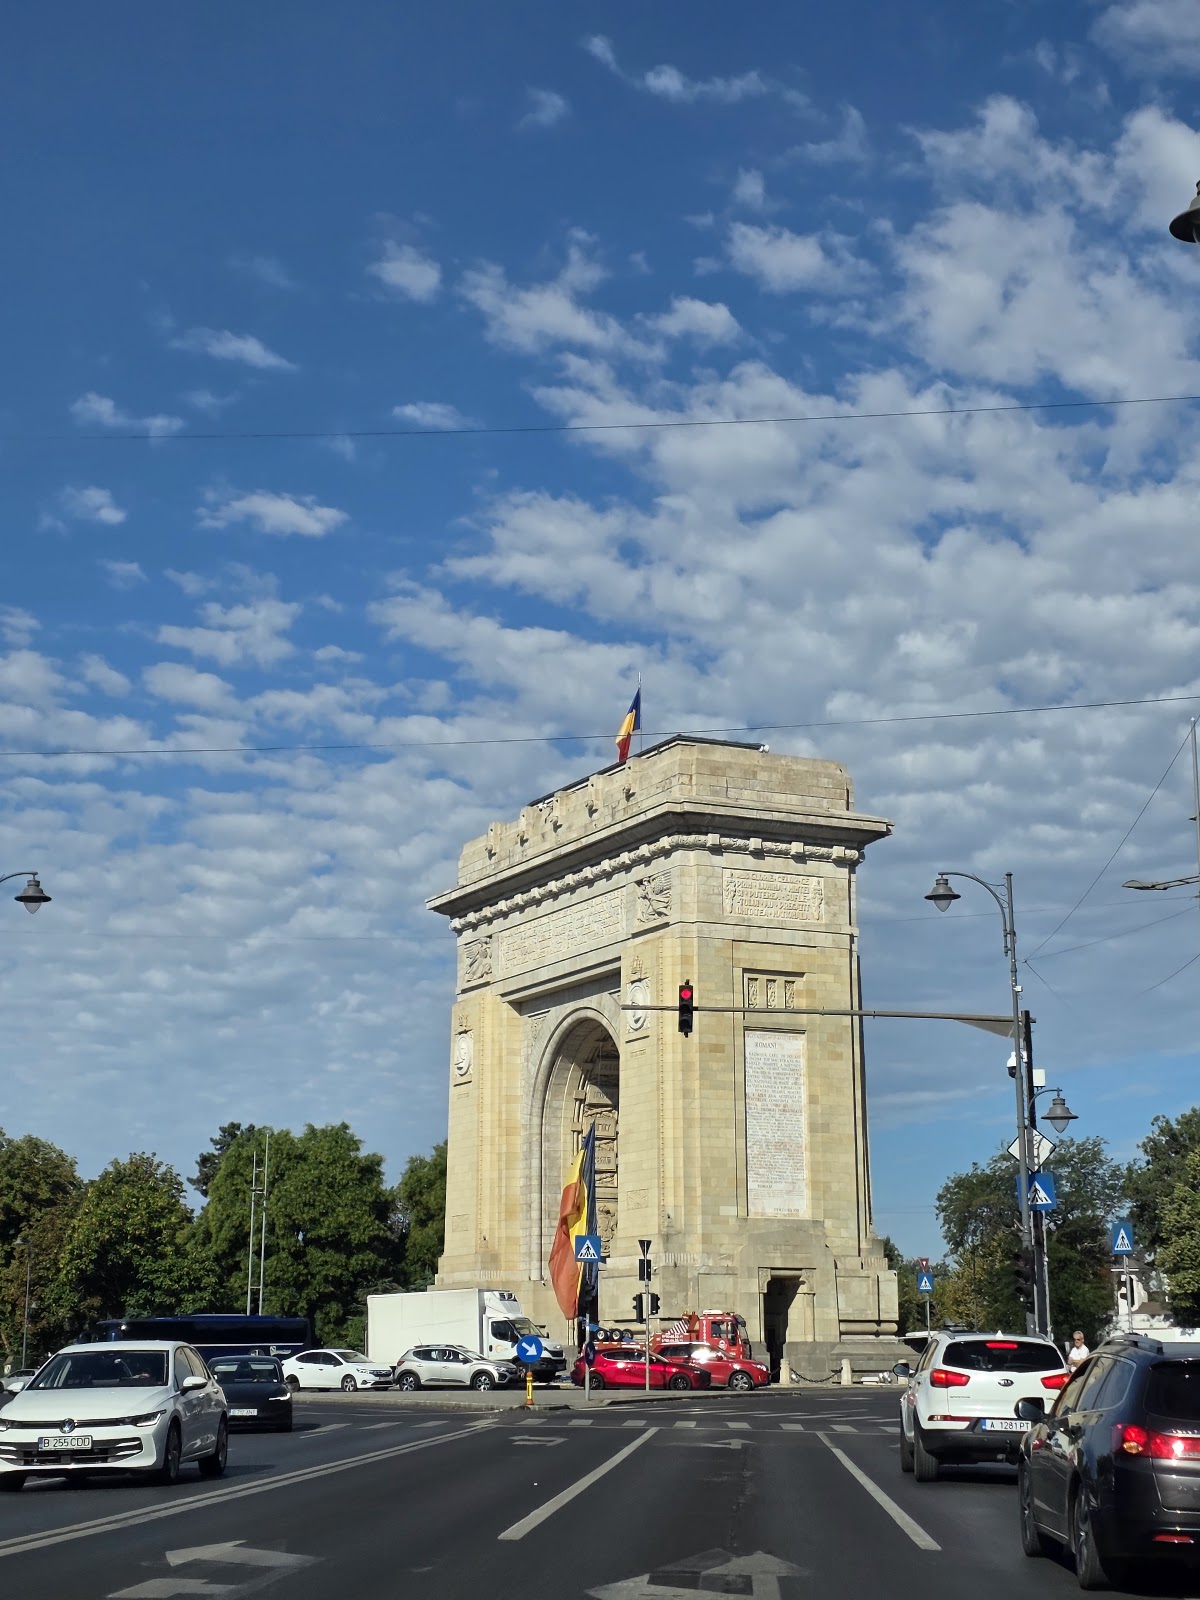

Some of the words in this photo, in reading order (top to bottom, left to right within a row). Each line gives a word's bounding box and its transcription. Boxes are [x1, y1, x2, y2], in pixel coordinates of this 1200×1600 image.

[990, 1421, 995, 1429] A
[1000, 1421, 1017, 1430] 1281
[1019, 1422, 1029, 1430] PT
[43, 1438, 49, 1447] B
[53, 1438, 69, 1447] 255
